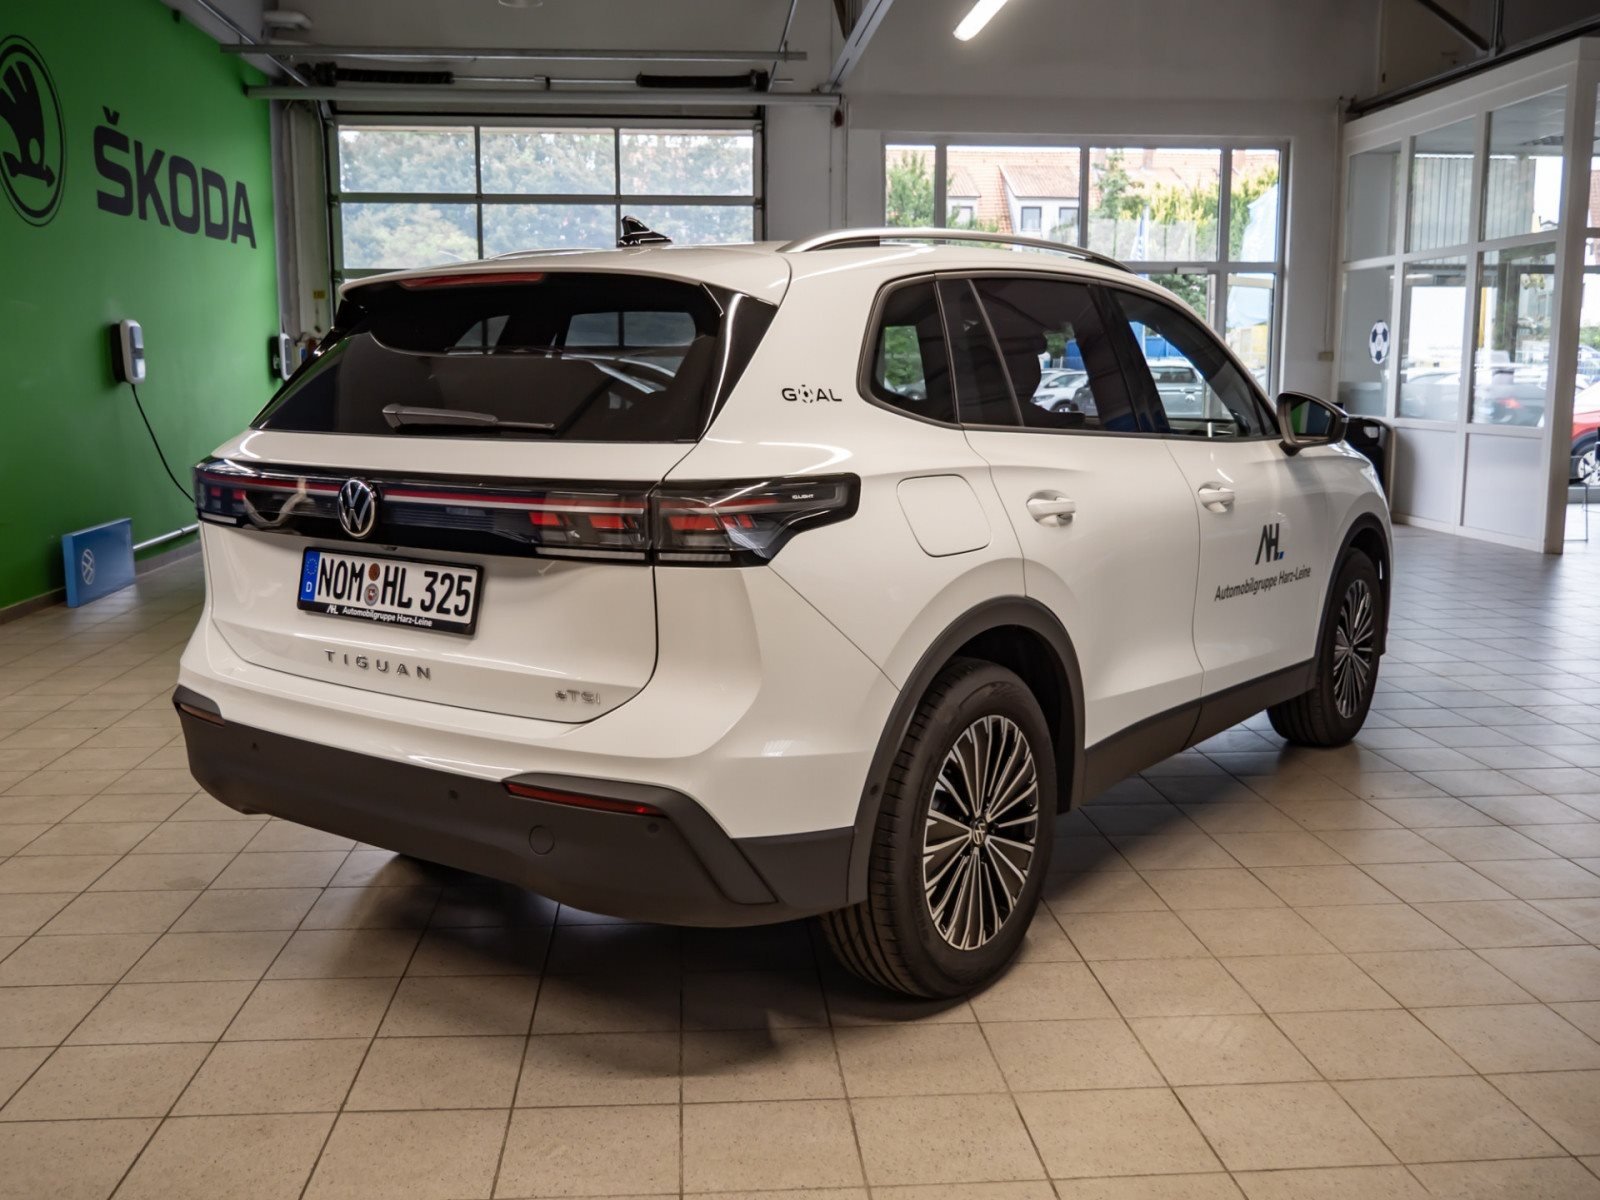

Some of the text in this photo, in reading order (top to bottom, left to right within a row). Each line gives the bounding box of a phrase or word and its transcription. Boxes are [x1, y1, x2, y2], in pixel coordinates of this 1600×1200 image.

[93, 105, 257, 249] ŠKODA
[781, 384, 842, 403] GOAL
[305, 581, 313, 593] D
[317, 557, 473, 617] NOM HL 325
[1214, 564, 1311, 602] Automobilgruppe Harz-Leine
[342, 605, 396, 622] Automobilgruppe
[396, 614, 433, 627] Harz-Leine
[324, 649, 432, 681] TIGUAN
[554, 690, 601, 704] eTSI
